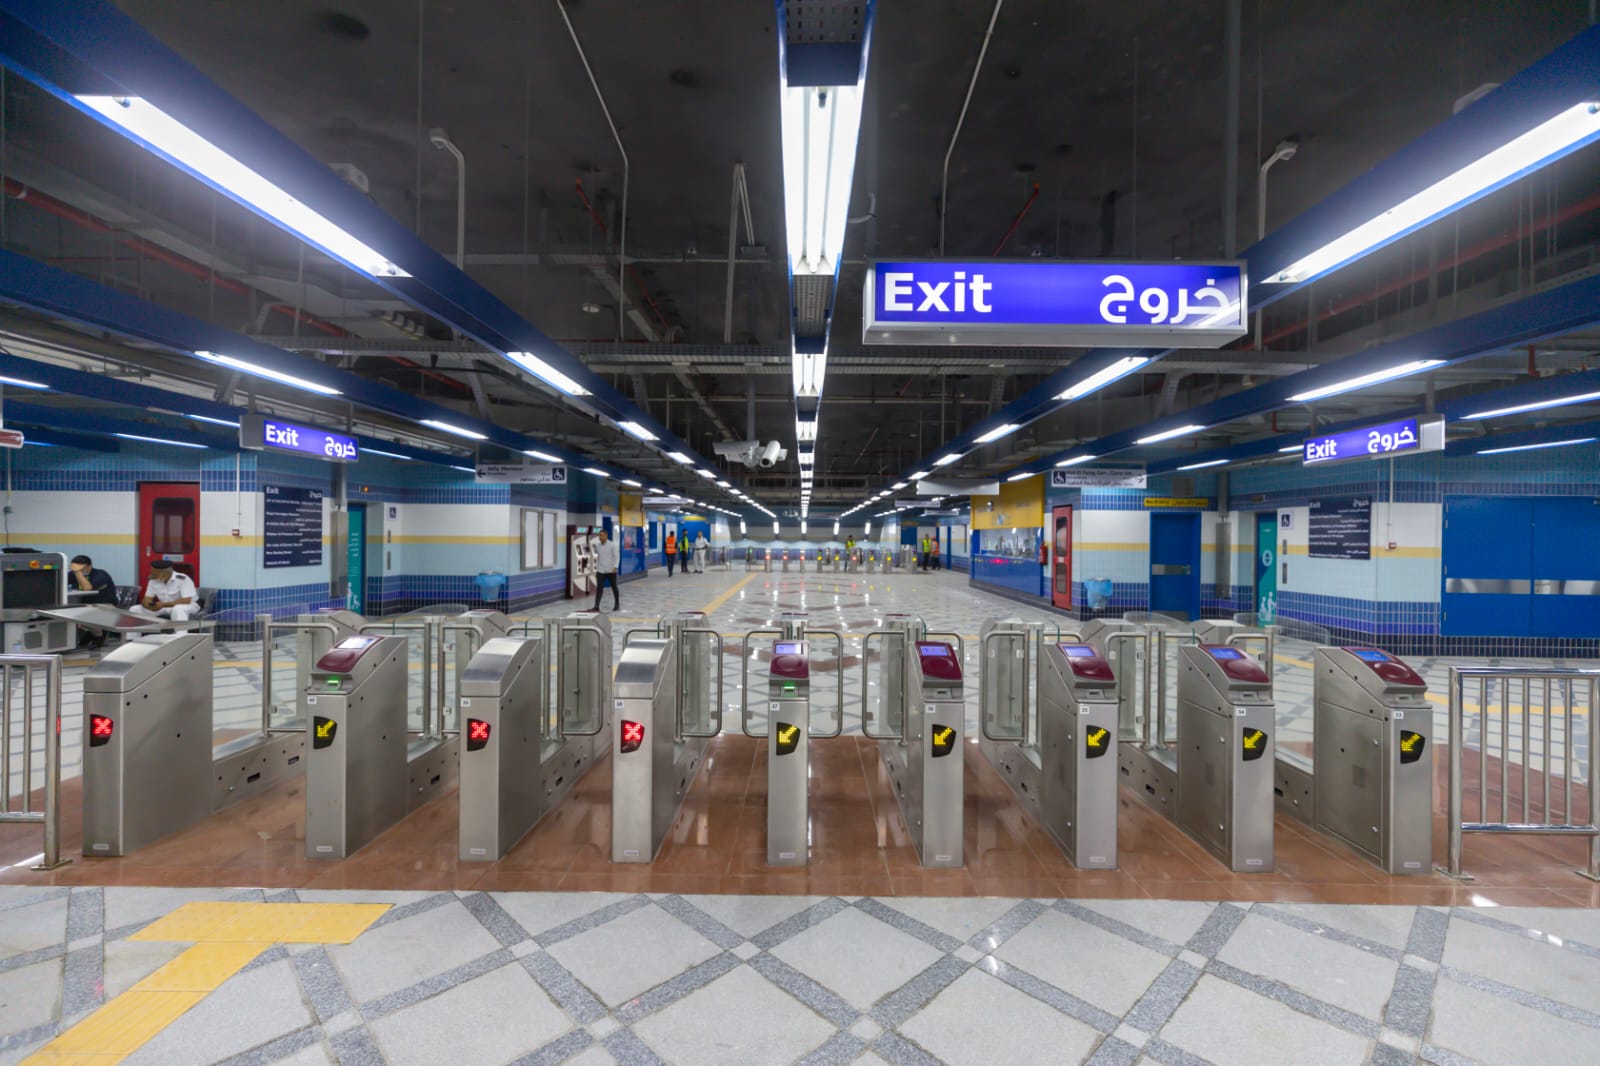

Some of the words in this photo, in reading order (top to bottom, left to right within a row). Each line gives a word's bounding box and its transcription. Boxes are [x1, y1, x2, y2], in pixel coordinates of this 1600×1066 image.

[884, 271, 992, 313] Exit
[1099, 275, 1238, 324] خروج
[266, 424, 299, 447] Exit
[324, 436, 356, 458] خروج
[1367, 426, 1417, 453] خروج
[1306, 439, 1337, 460] Exit
[266, 486, 279, 495] Exit
